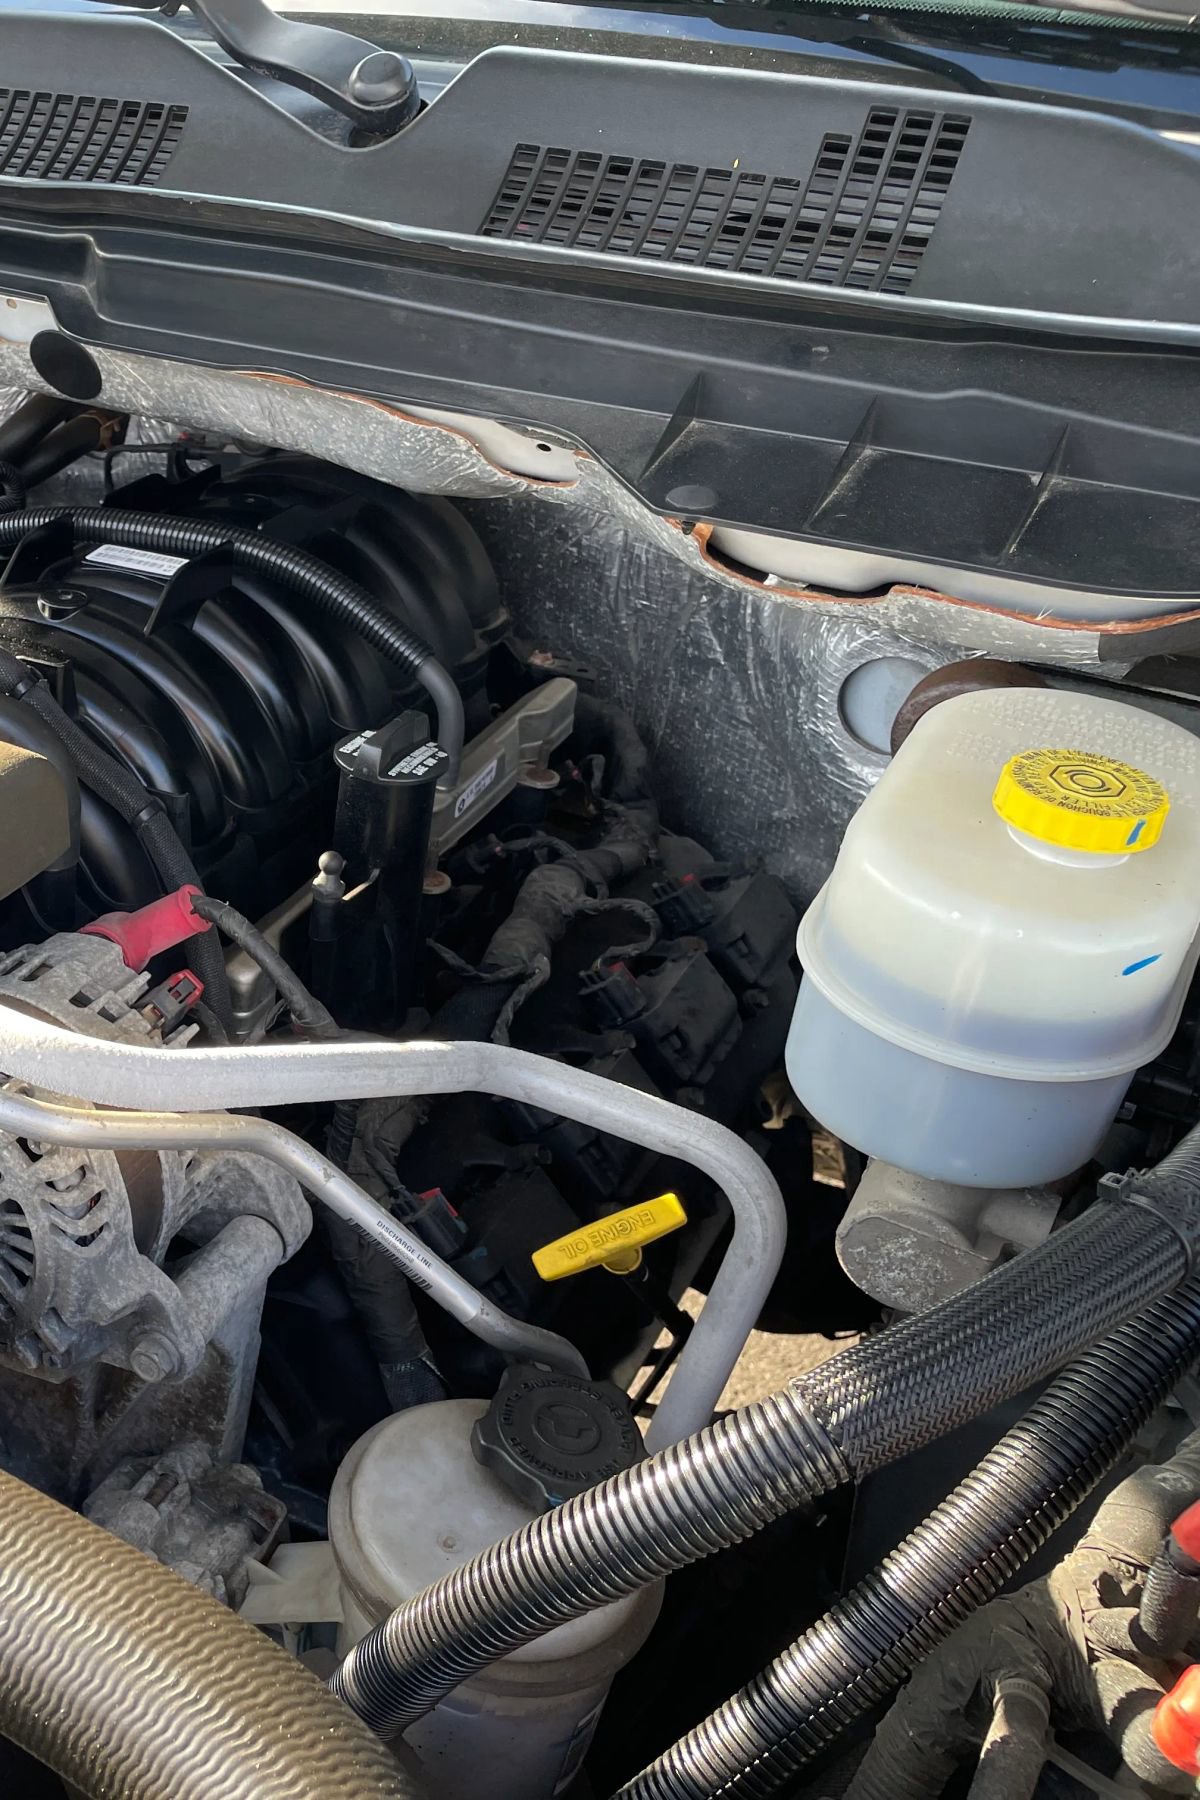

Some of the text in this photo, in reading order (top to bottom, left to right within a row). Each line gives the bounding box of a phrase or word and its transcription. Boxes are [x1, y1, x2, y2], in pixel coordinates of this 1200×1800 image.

[1039, 794, 1056, 803] DE
[1056, 800, 1113, 818] BOUCHON
[1059, 794, 1112, 810] FILLER
[377, 1220, 416, 1255] DISCHARGE
[416, 1254, 433, 1270] LINE
[559, 1209, 655, 1259] ENGINE OIL
[509, 1437, 590, 1480] APPROVED
